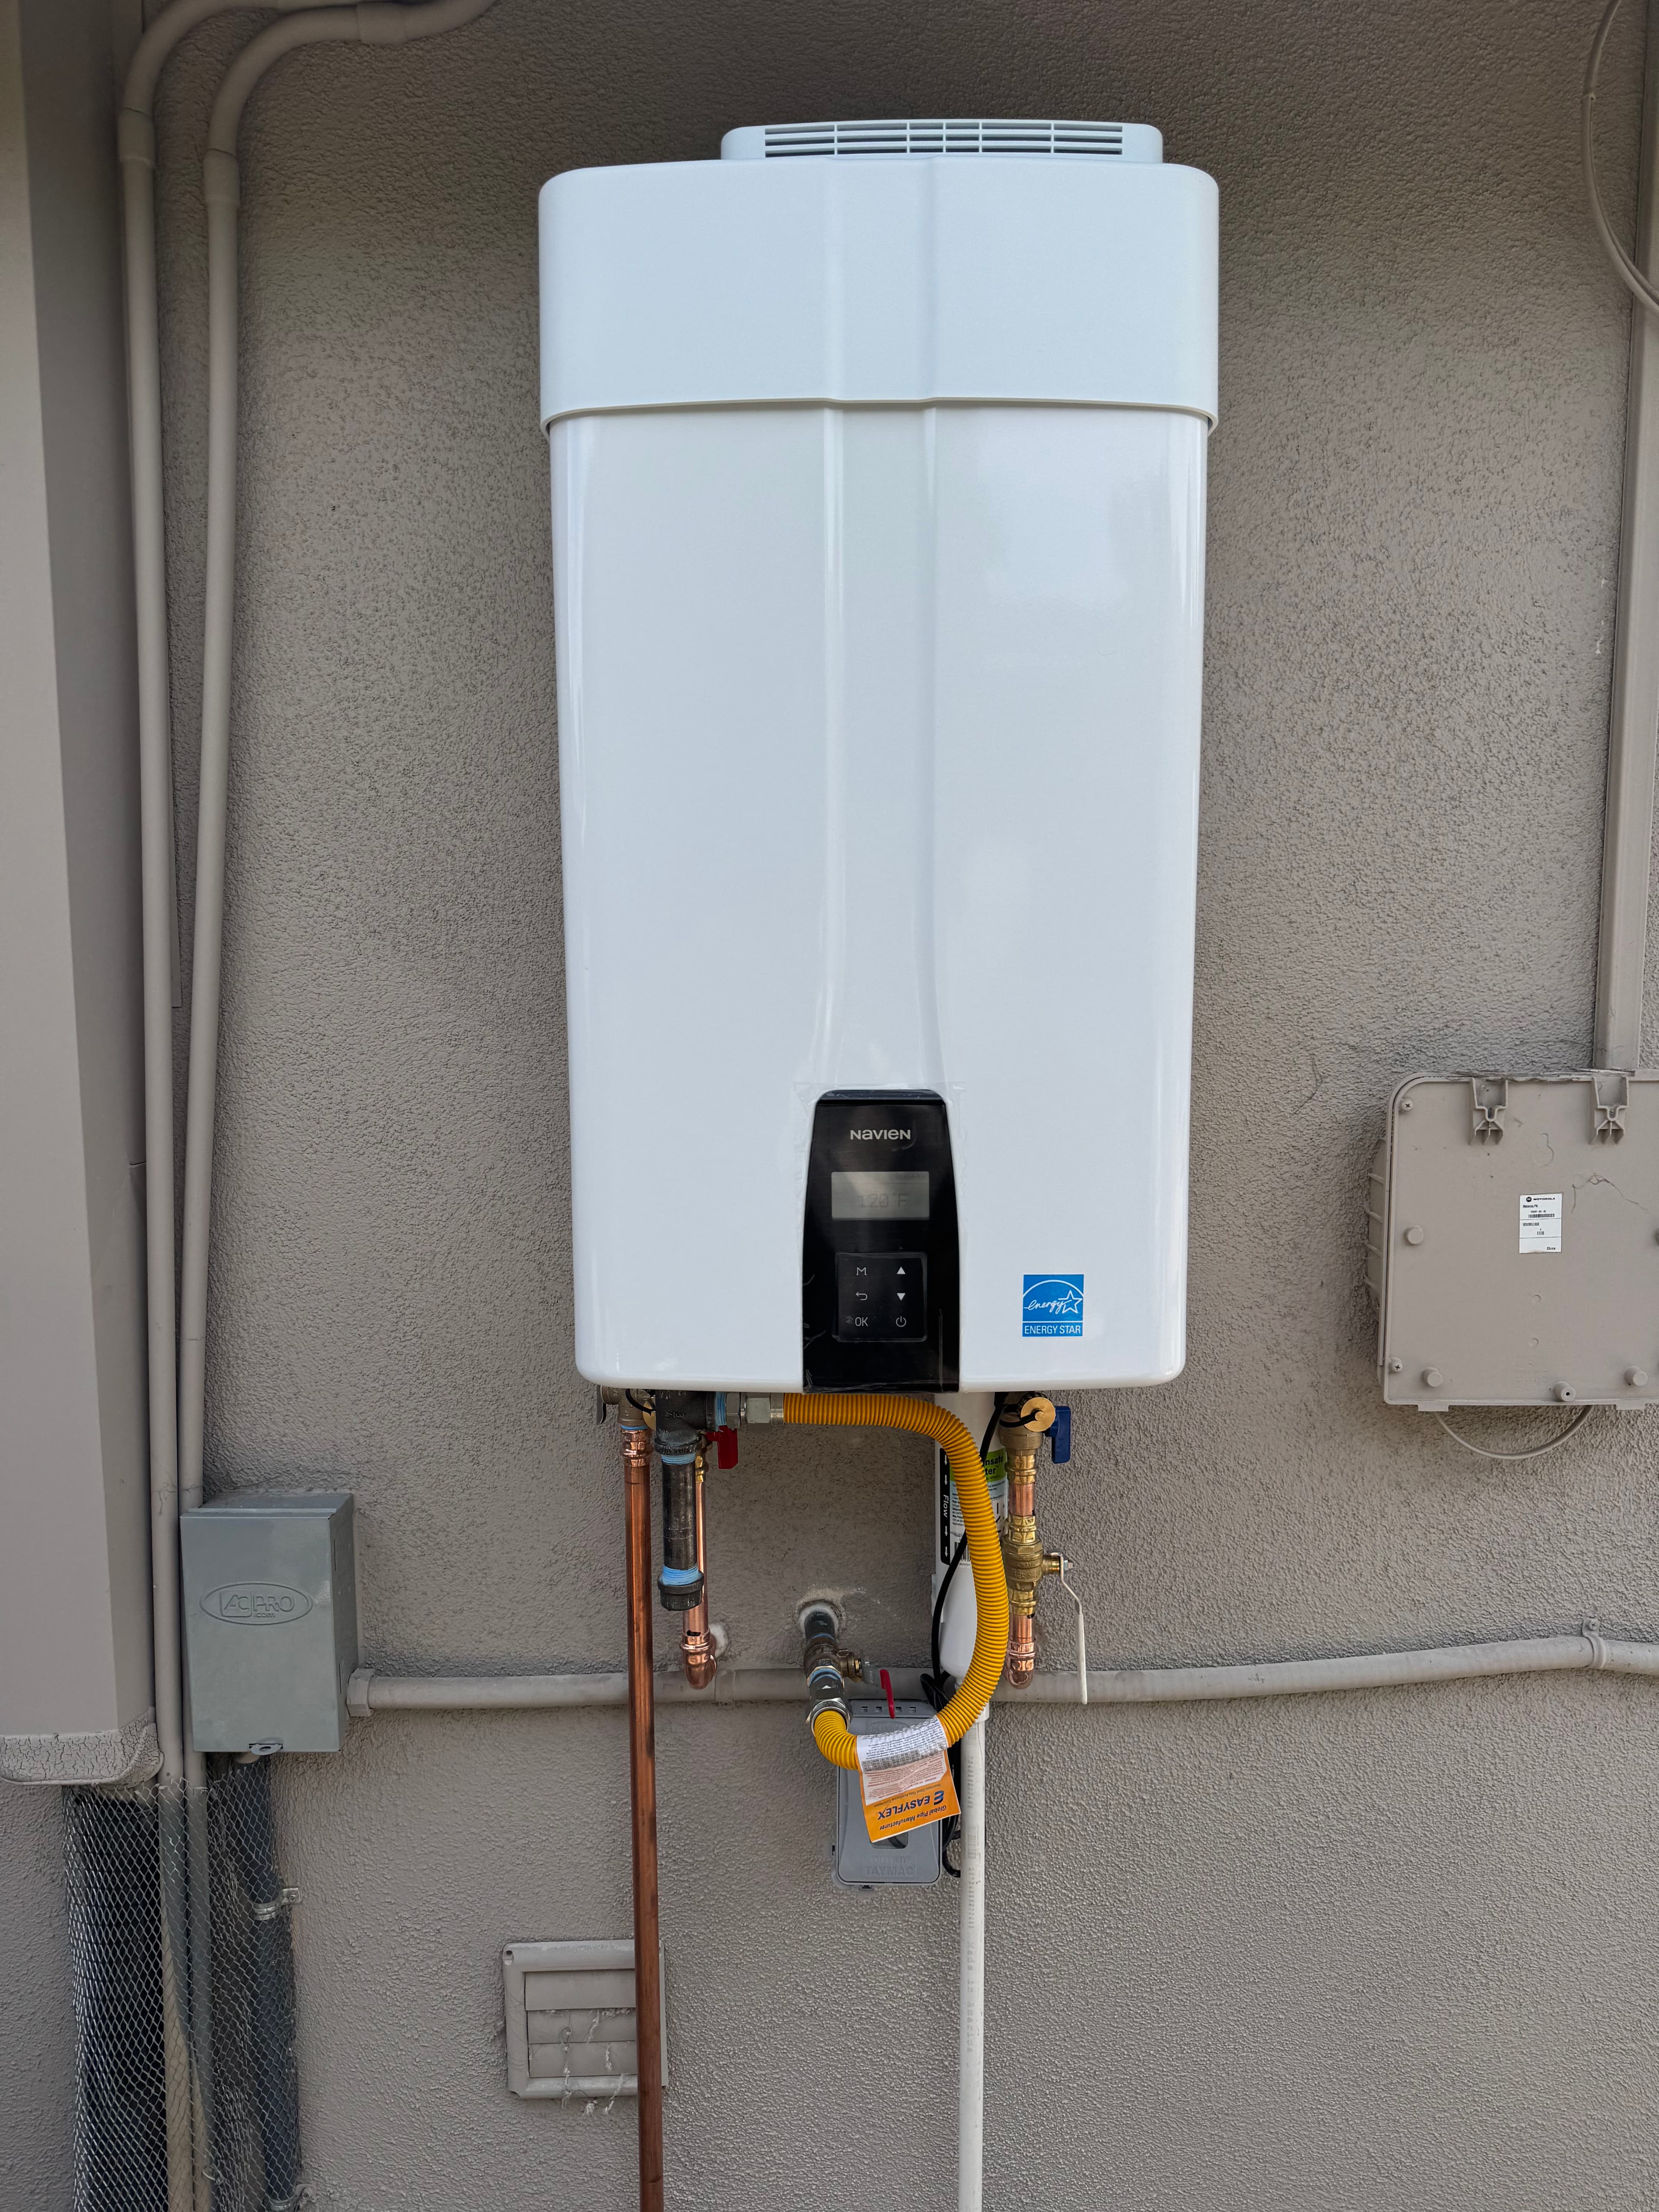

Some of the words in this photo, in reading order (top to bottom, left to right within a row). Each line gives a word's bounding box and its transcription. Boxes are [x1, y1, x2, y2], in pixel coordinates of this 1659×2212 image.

[856, 1267, 867, 1276] M
[1025, 1300, 1065, 1314] energy
[855, 1316, 868, 1327] OK
[1024, 1325, 1058, 1334] ENERGY
[1059, 1325, 1081, 1334] STAR
[878, 1796, 930, 1820] EASYFLEX
[929, 1805, 947, 1816] Global
[880, 1815, 915, 1830] Manufacturer
